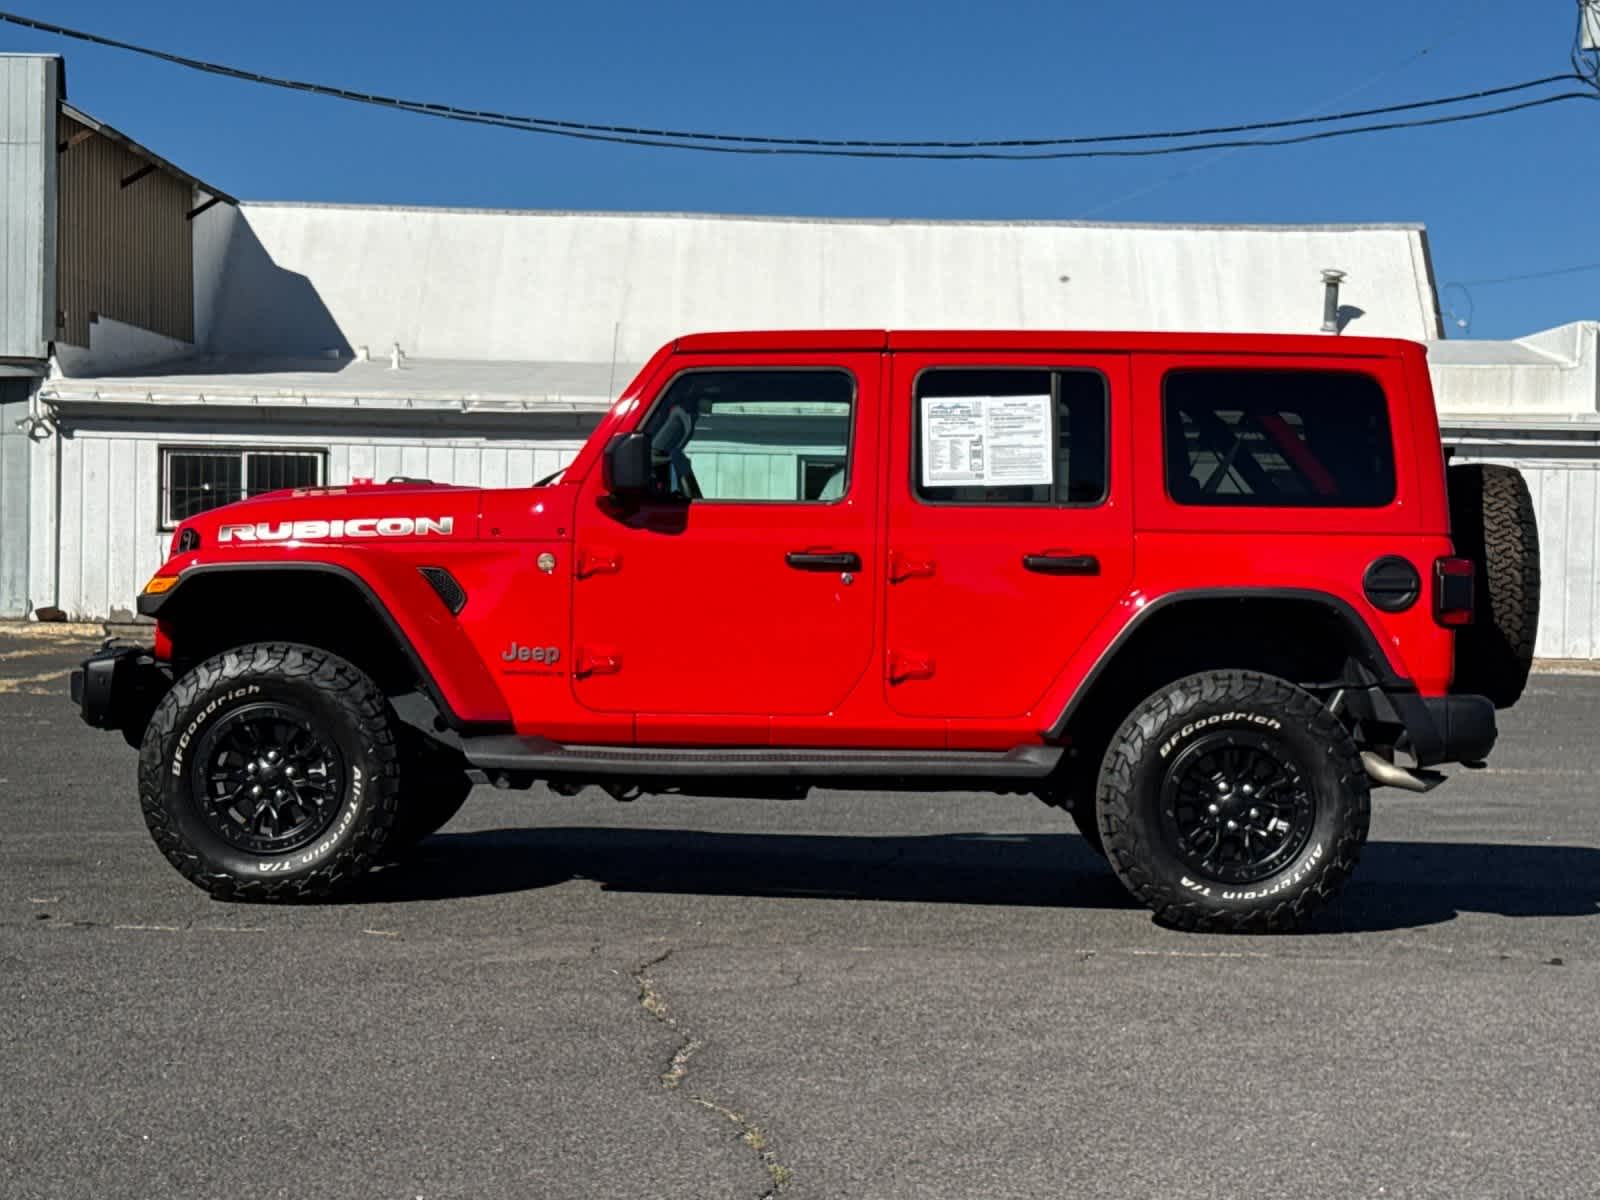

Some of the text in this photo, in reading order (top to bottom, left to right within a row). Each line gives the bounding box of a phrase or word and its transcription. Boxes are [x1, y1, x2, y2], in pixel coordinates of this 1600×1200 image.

[217, 516, 454, 542] RUBICON
[502, 641, 560, 665] Jeep
[172, 684, 260, 777] BFGoodrich
[1160, 711, 1281, 758] BFGoodrich
[259, 765, 361, 872] All-Terrain T/A
[1180, 843, 1324, 900] All-Terrain T/A
